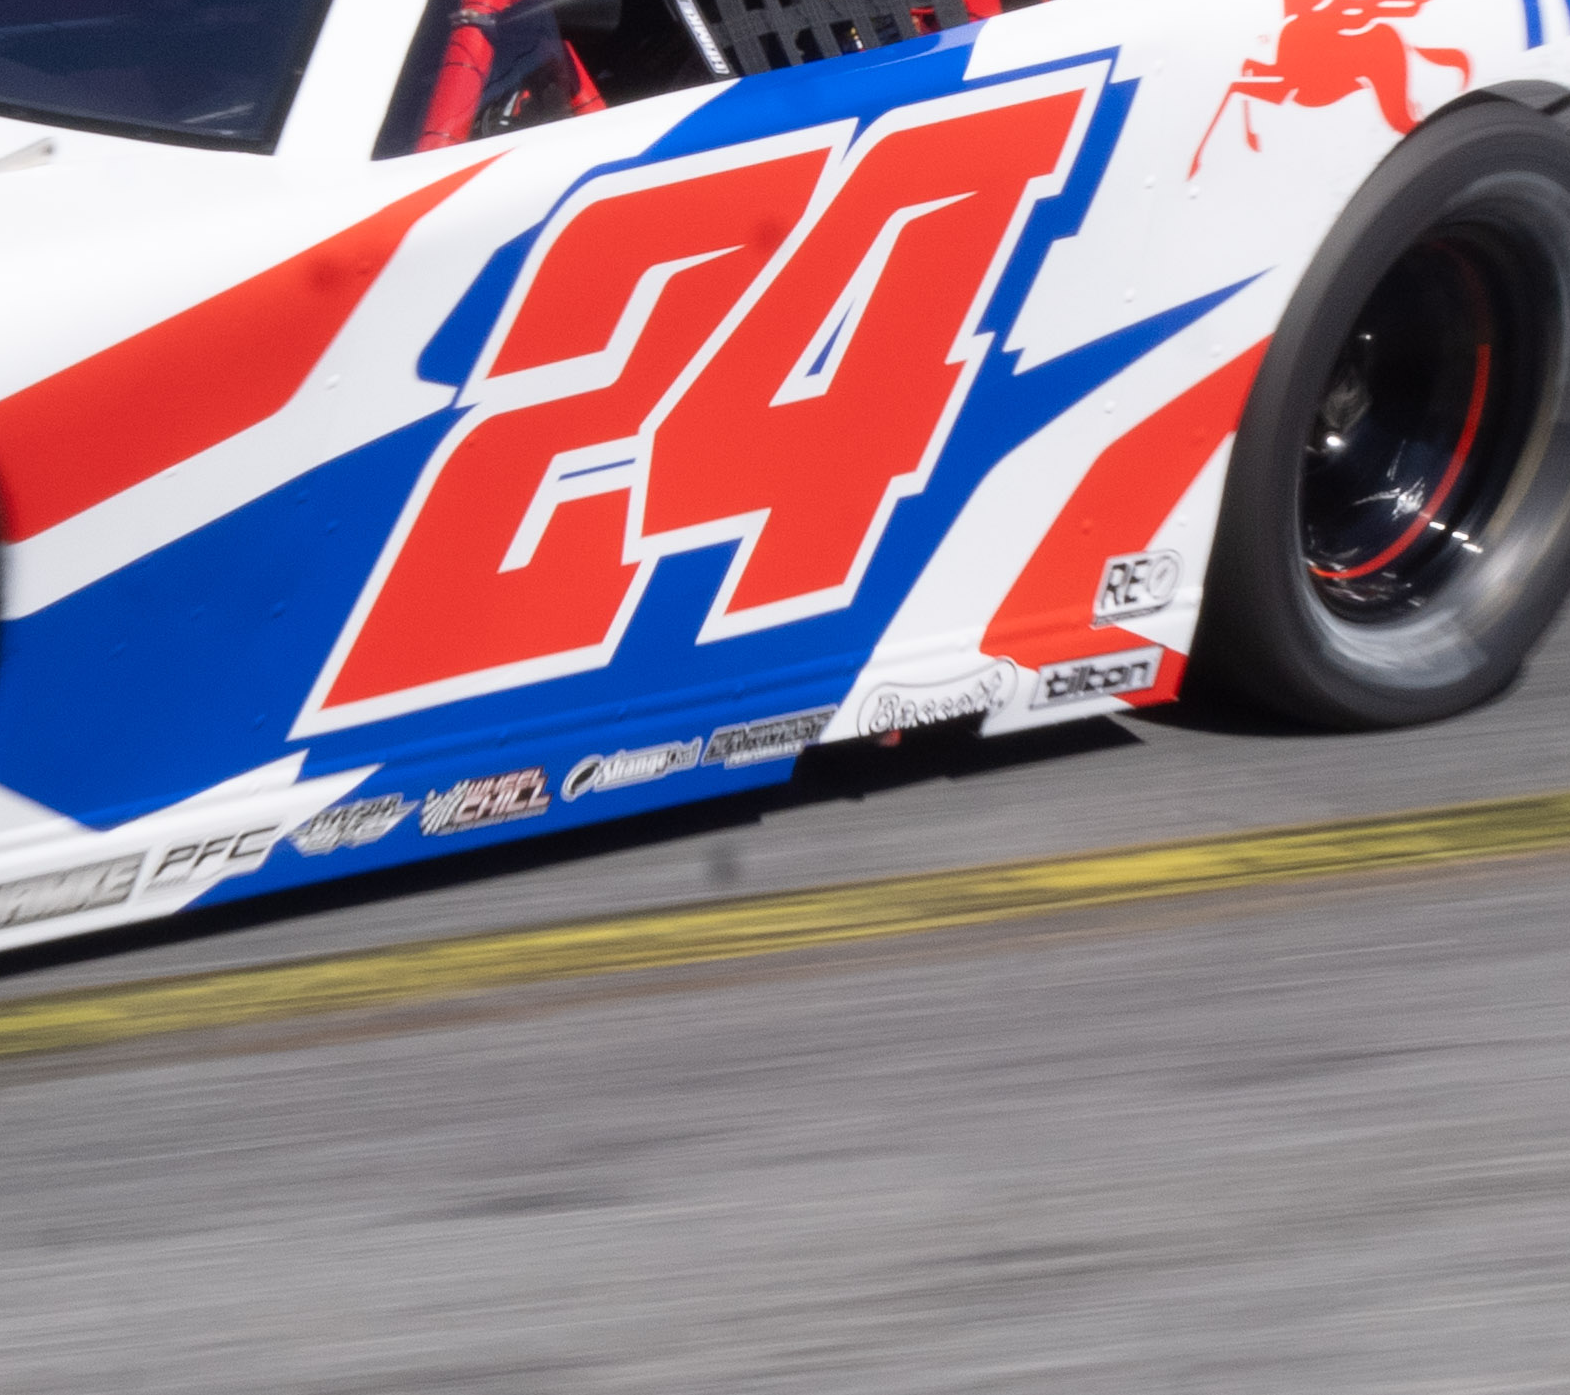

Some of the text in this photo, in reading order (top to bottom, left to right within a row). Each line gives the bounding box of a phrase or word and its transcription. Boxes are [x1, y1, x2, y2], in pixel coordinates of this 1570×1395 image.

[319, 86, 1088, 712] 24
[1046, 661, 1150, 700] tilton
[453, 777, 552, 824] CHILL
[466, 766, 544, 798] WHEEL
[153, 823, 281, 879] PFC
